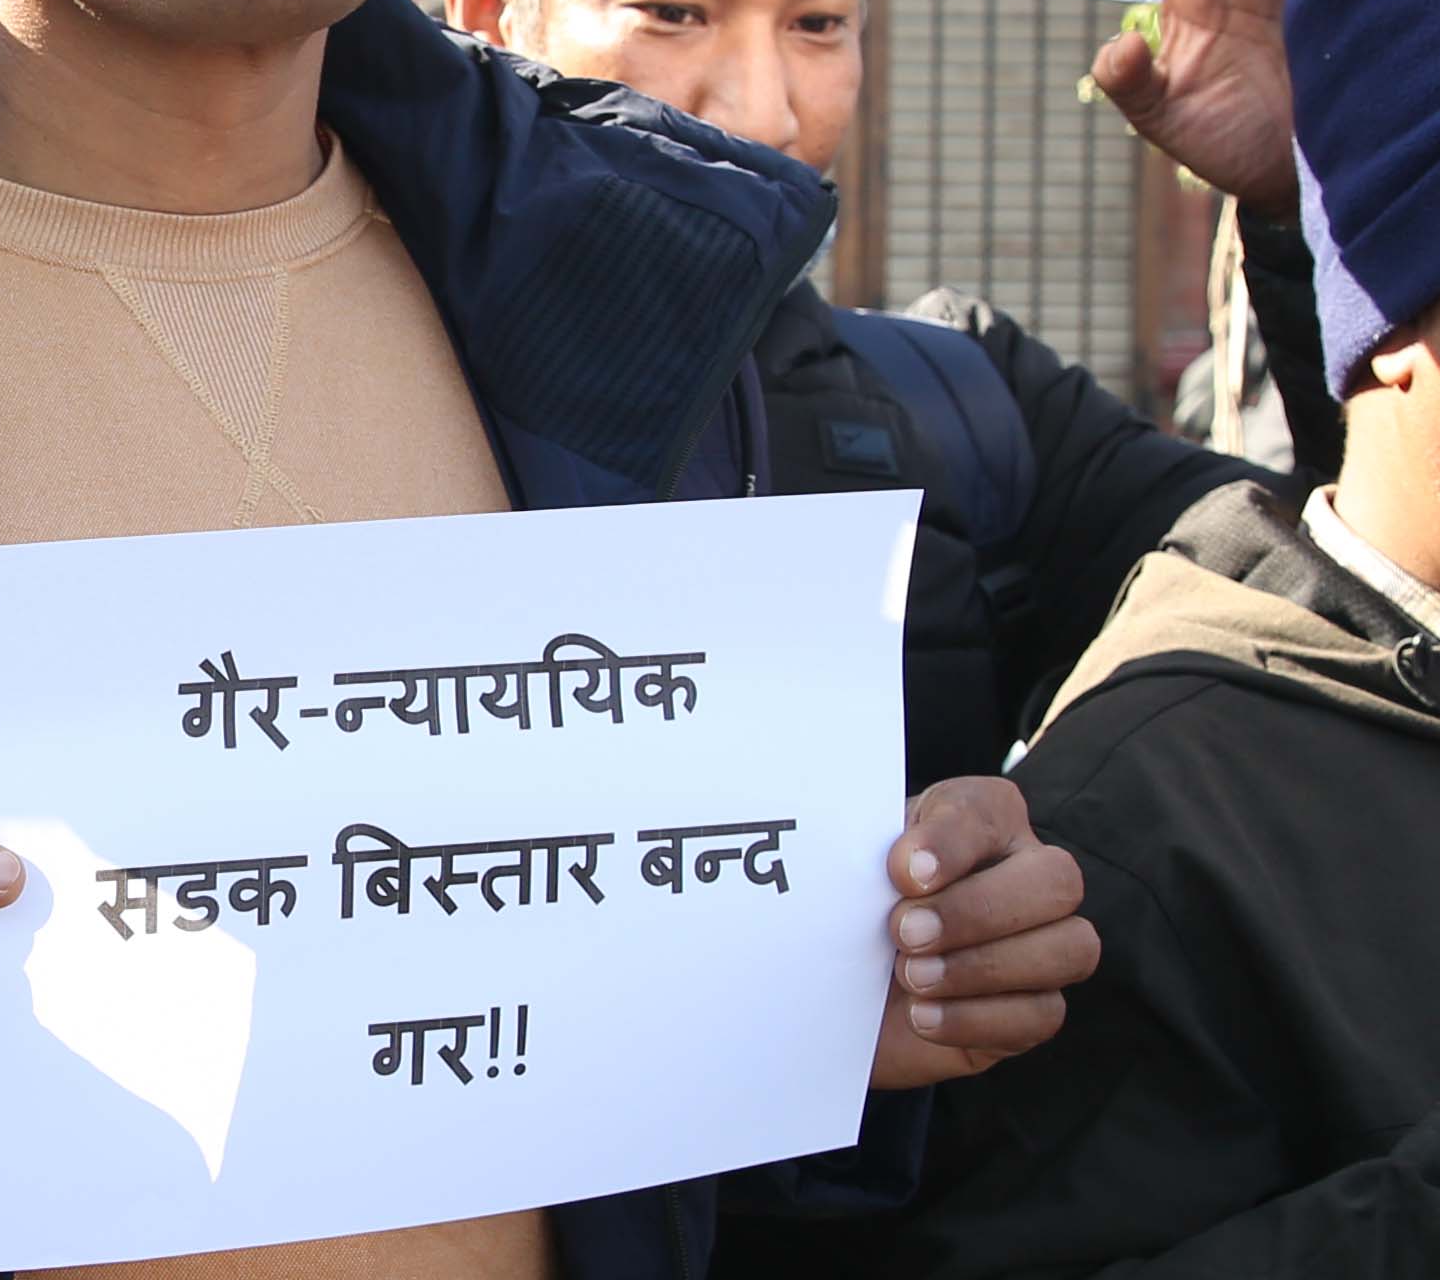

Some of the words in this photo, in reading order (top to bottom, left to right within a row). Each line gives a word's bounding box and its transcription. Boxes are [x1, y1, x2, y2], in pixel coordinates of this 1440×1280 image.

[96, 855, 308, 941] सडक
[332, 823, 615, 919] बिस्तार
[637, 819, 797, 895] बन्द
[368, 1004, 528, 1086] गर!!
